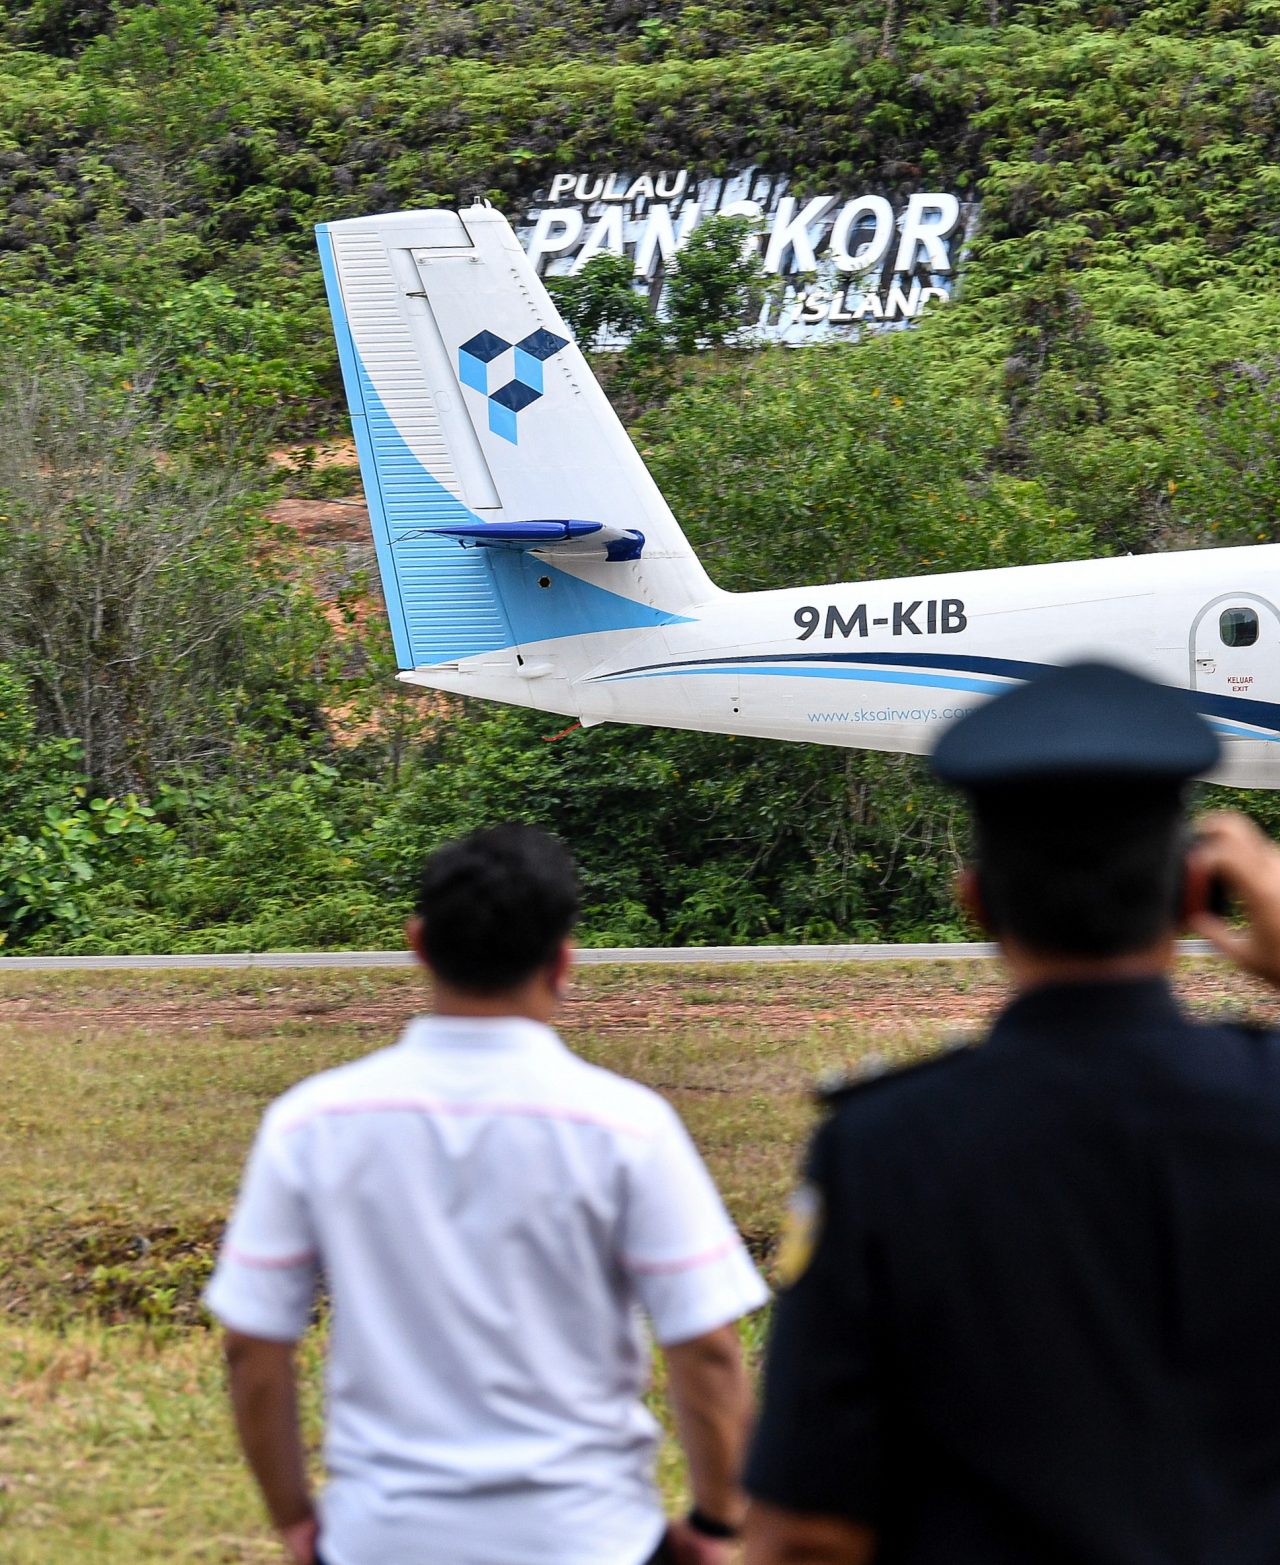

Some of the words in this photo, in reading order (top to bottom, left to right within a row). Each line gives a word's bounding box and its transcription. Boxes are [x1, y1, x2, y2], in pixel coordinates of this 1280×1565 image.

[549, 169, 688, 202] PULAU
[793, 598, 968, 641] 9M-KIB
[1227, 676, 1254, 684] KELUAR
